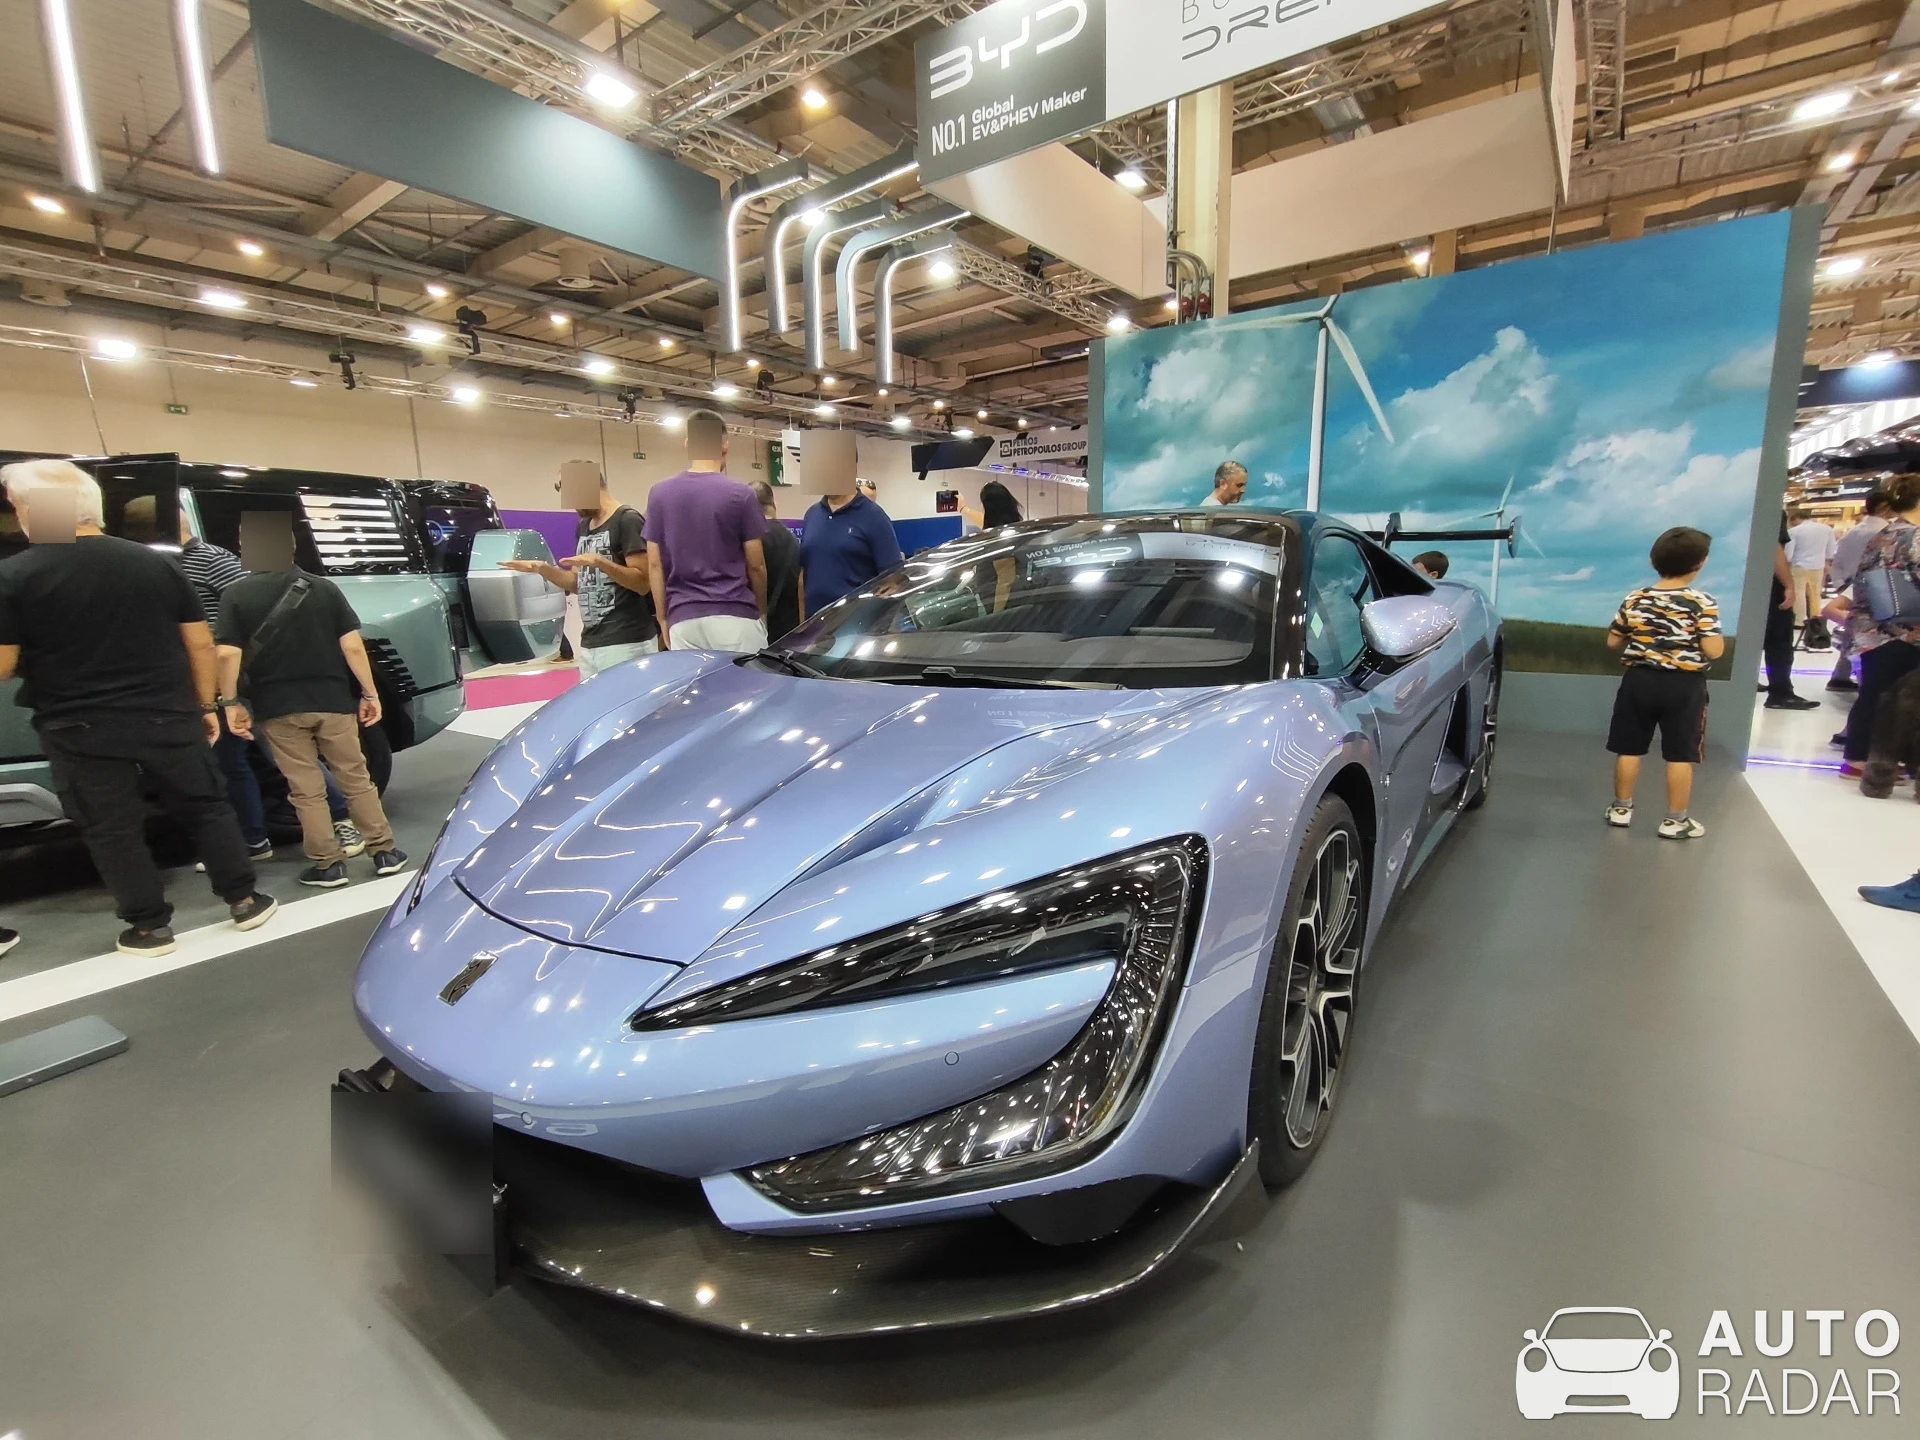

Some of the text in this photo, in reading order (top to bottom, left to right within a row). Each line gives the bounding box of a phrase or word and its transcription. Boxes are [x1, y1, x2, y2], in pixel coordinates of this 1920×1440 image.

[929, 0, 1087, 99] BYD
[1182, 0, 1332, 60] DRE
[971, 94, 1014, 124] Global
[972, 87, 1087, 141] EV&PHEV Maker
[931, 114, 966, 156] NO.1
[1013, 437, 1038, 447] PETROS
[1013, 441, 1087, 456] PETROPOULOS GROUP
